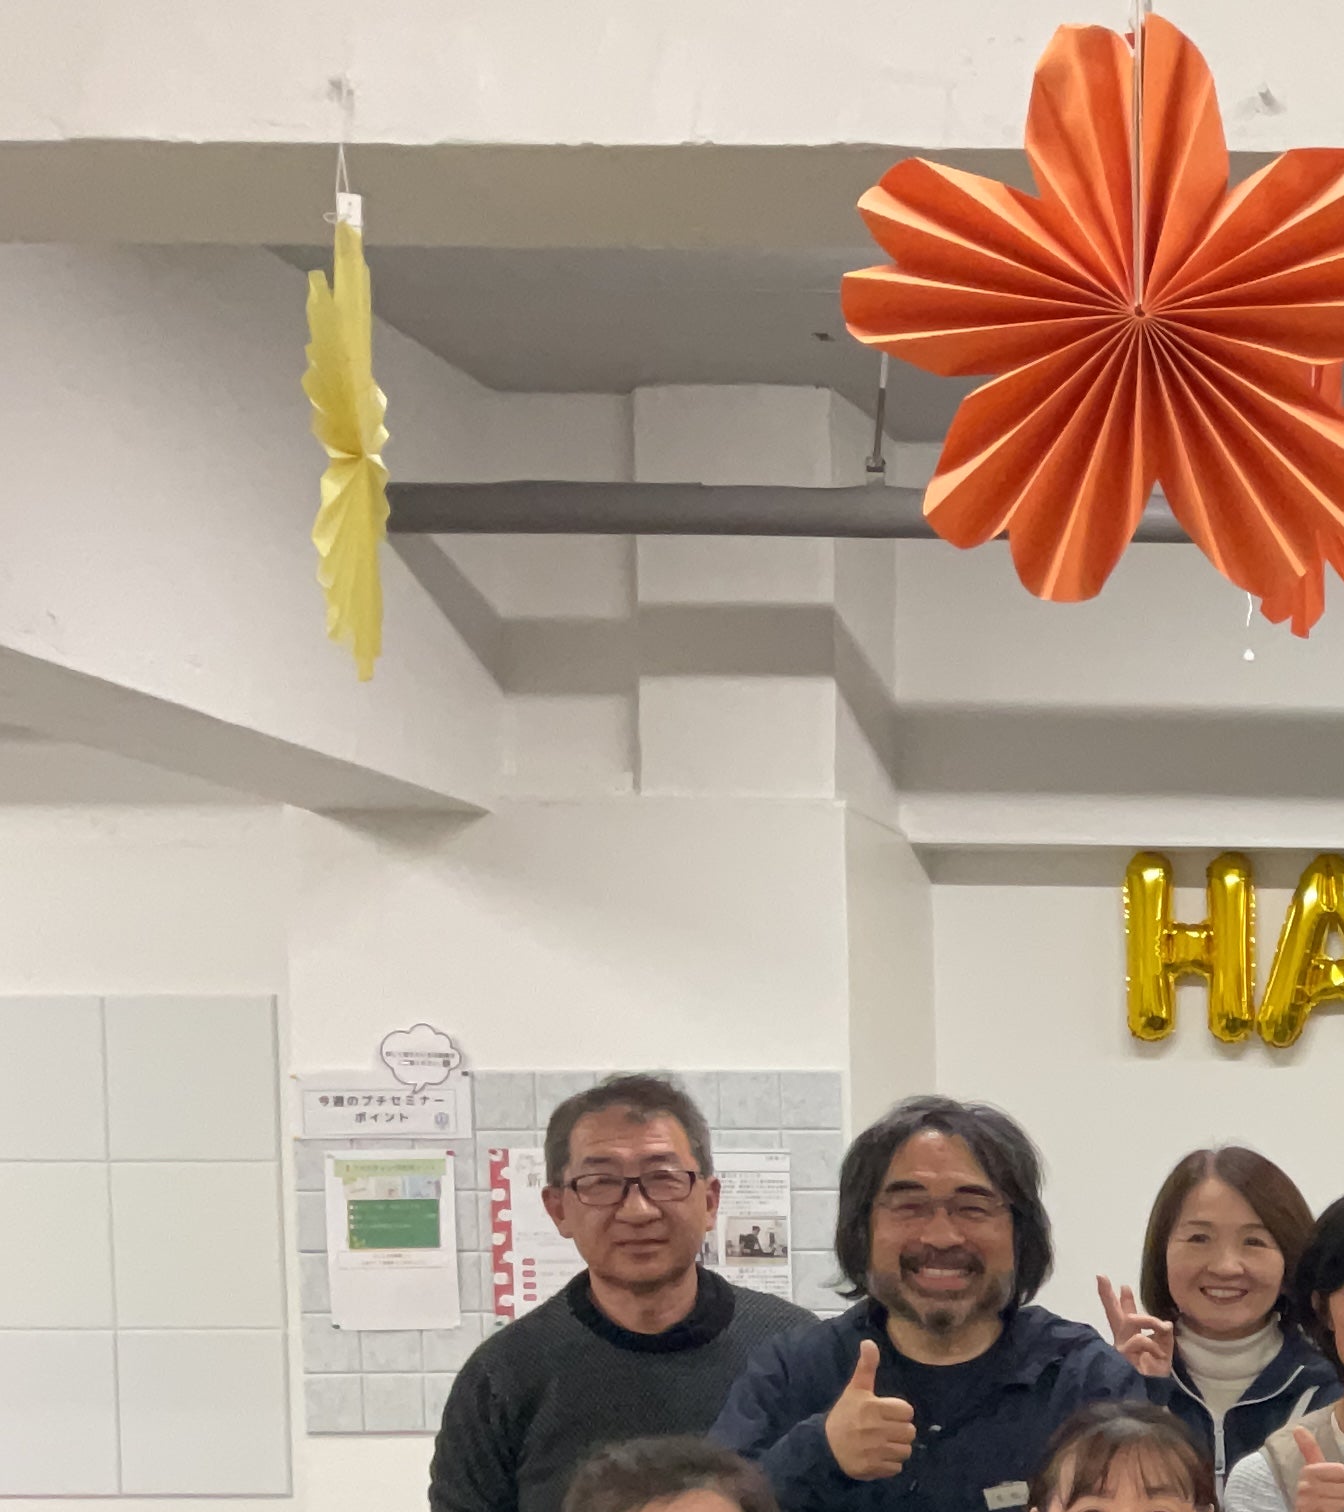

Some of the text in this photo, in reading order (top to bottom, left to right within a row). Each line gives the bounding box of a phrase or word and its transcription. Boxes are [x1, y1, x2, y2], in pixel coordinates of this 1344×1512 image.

[319, 1095, 445, 1108] 今週のプチセミナー
[355, 1112, 409, 1123] ポイント
